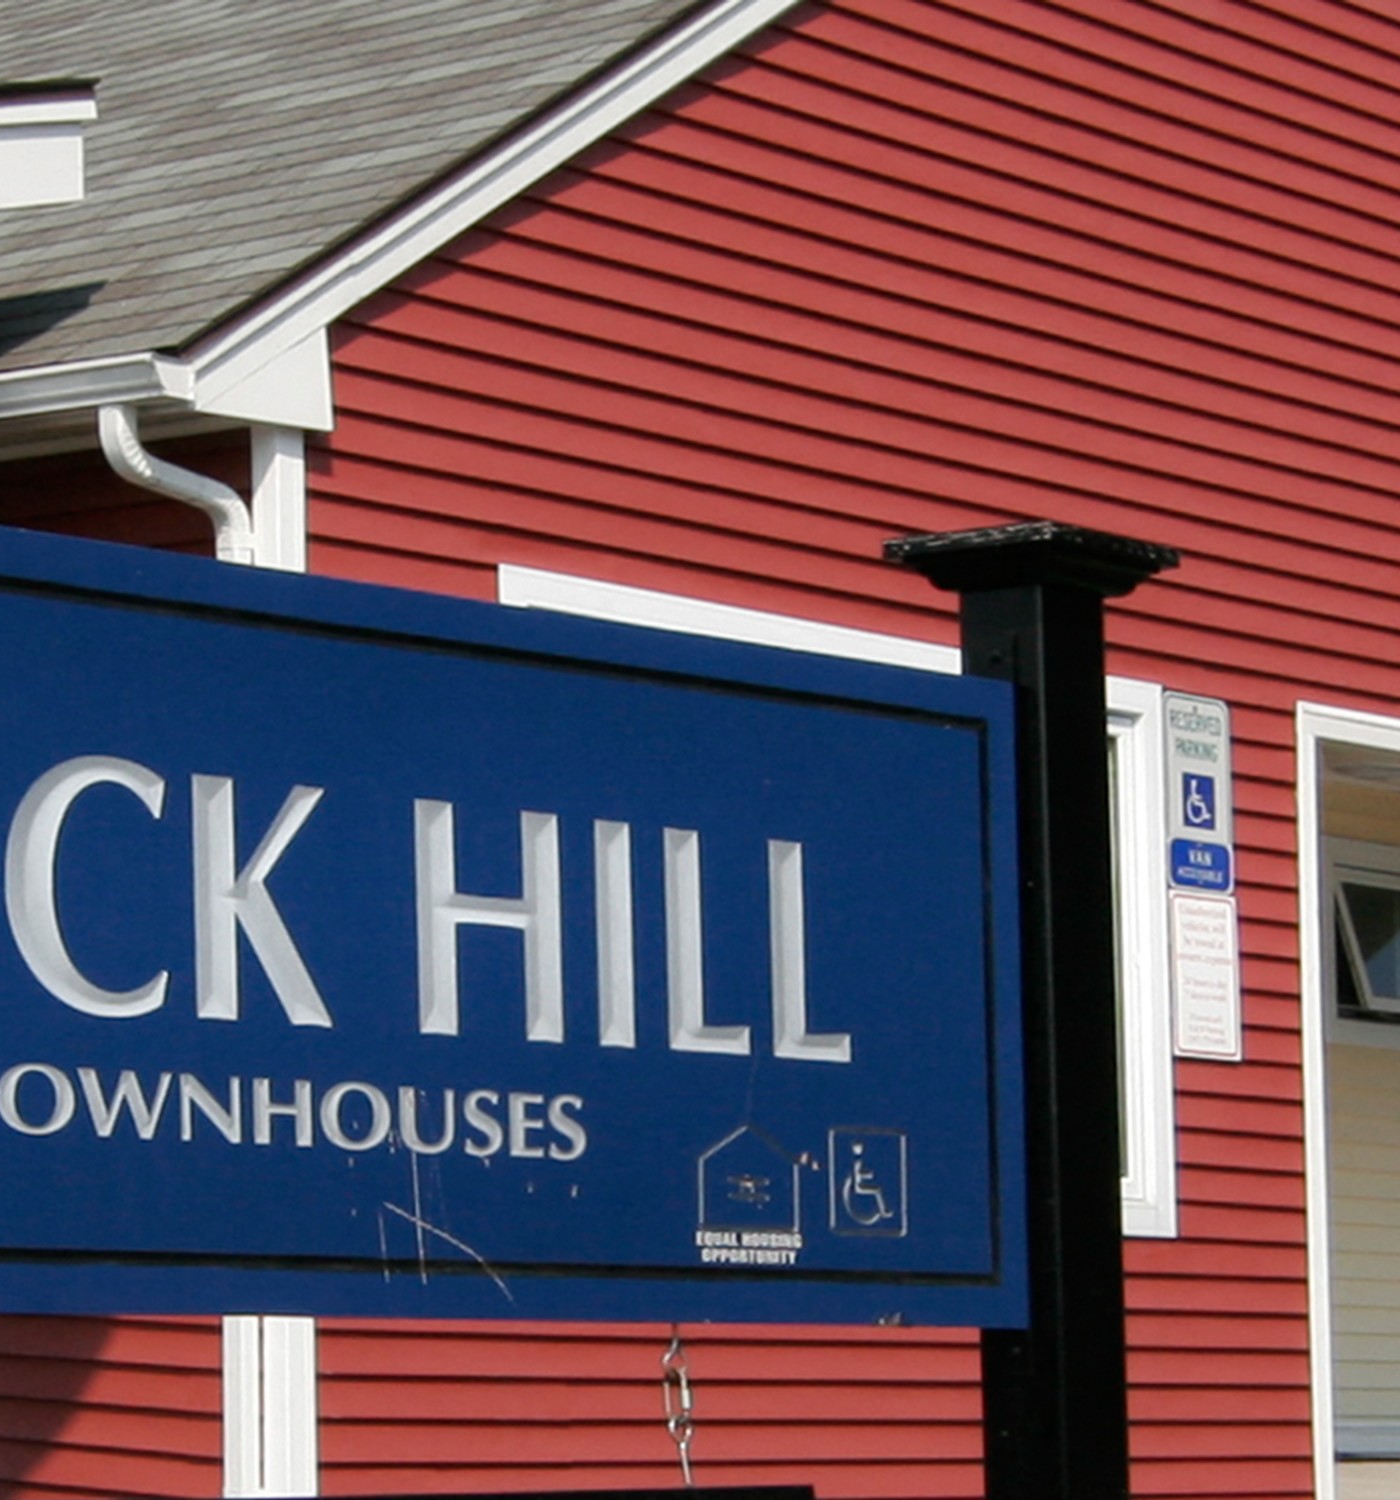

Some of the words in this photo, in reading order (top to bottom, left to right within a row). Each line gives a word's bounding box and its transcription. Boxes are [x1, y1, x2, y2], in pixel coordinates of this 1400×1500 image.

[1188, 849, 1213, 867] VAN
[413, 797, 854, 1065] HILL
[695, 1231, 739, 1247] EQUAL
[741, 1231, 803, 1249] HOUSING
[701, 1247, 797, 1265] OPPORTUNITY
